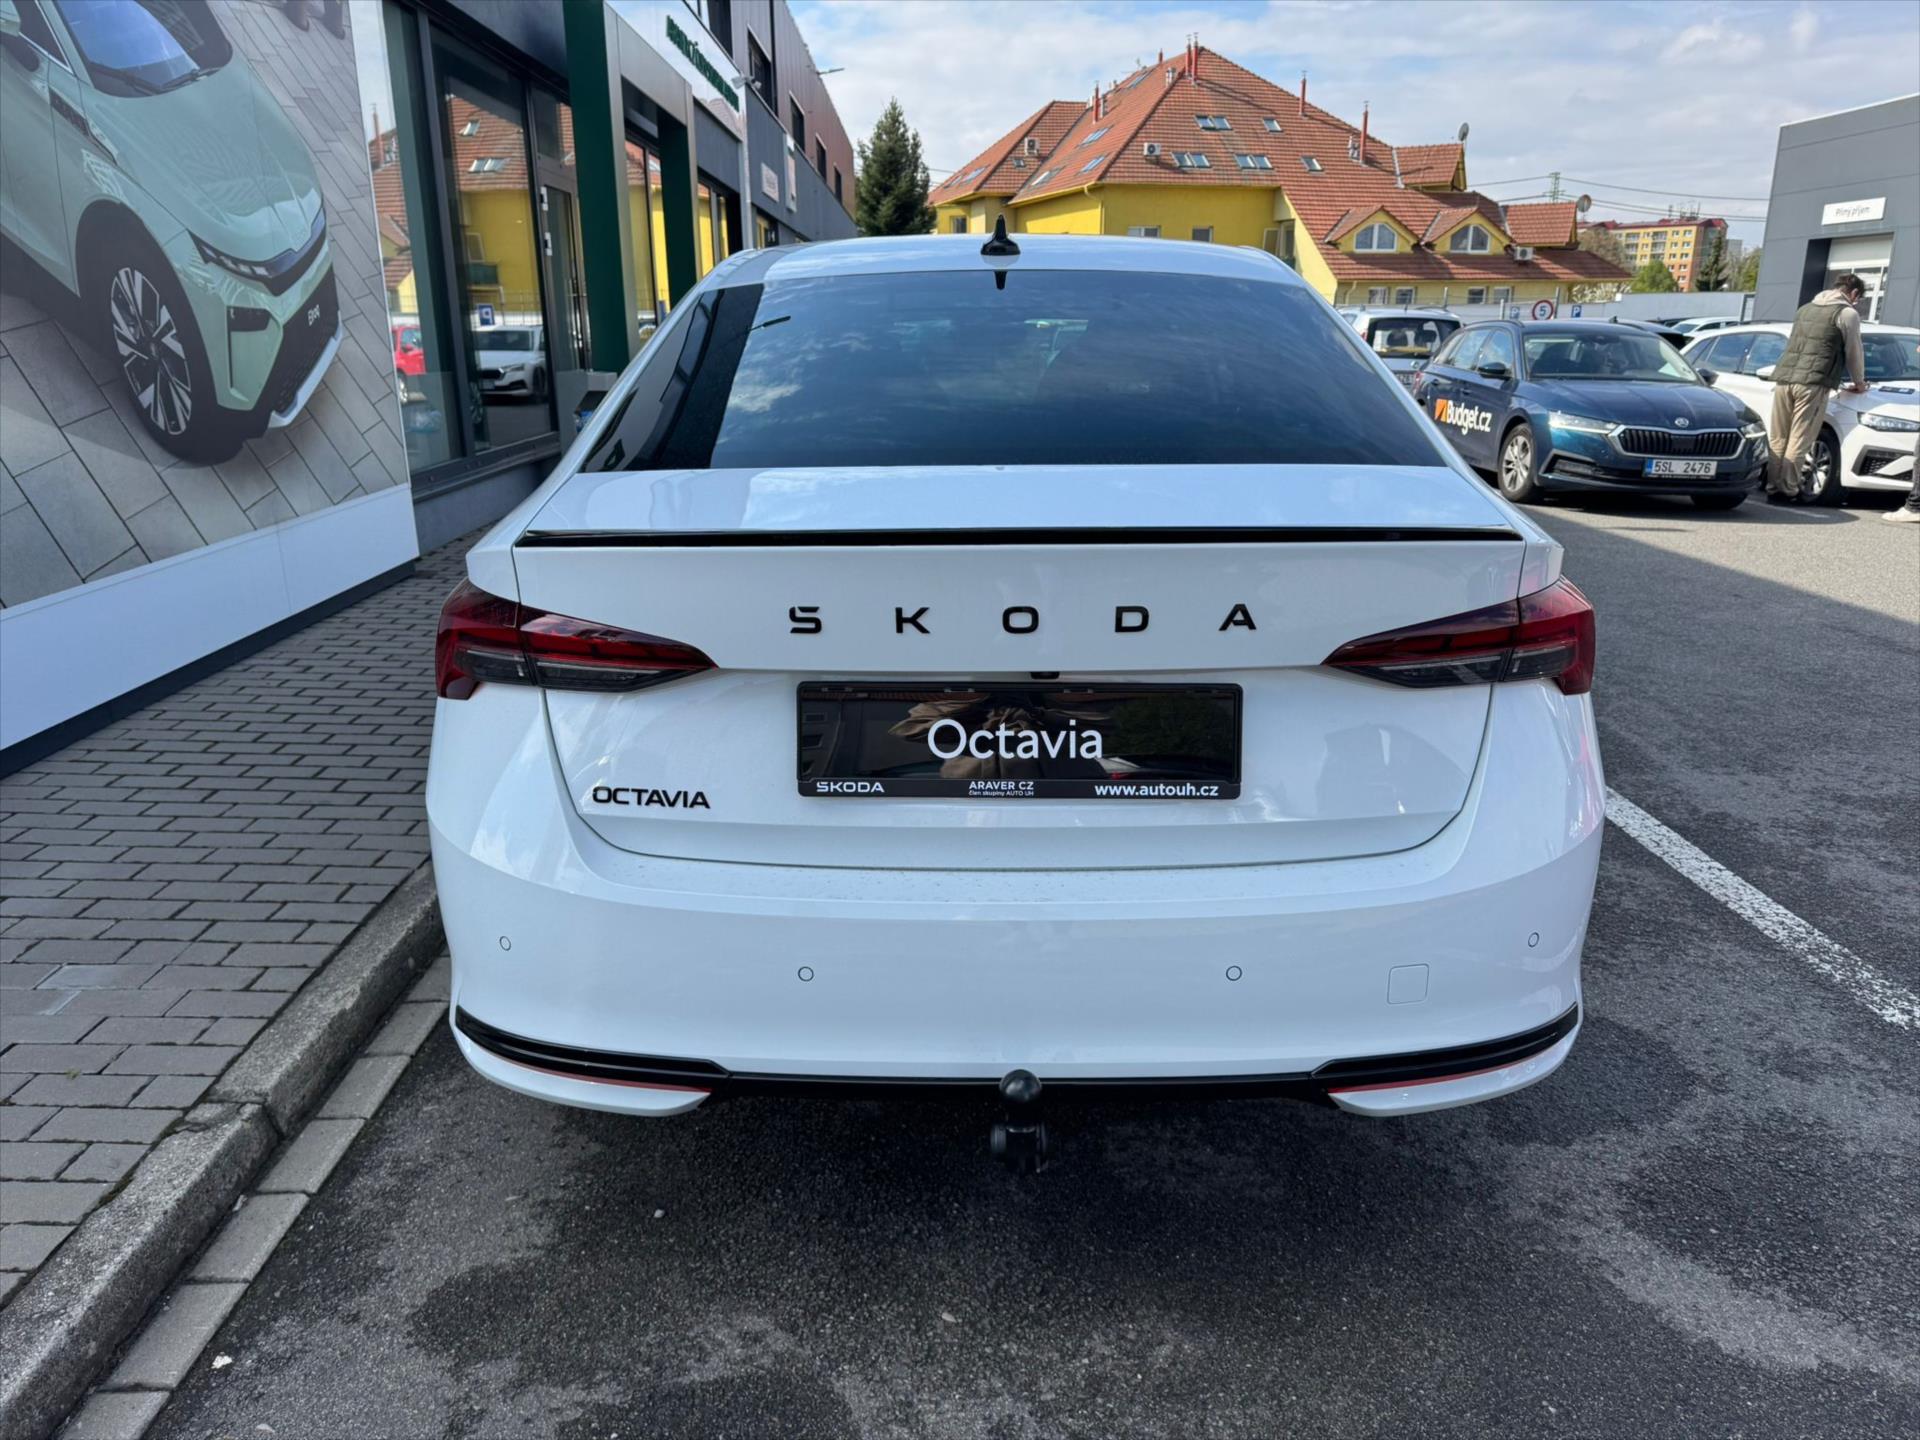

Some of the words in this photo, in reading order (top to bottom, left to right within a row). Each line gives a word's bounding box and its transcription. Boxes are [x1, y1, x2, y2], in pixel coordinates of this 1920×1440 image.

[1539, 305, 1547, 317] 5
[1447, 399, 1492, 436] Budget.cz
[1654, 461, 1674, 473] 5SL
[1683, 462, 1712, 474] 2476
[927, 718, 1103, 759] Octavia
[969, 781, 1015, 790] ARAVER
[1018, 781, 1034, 790] CZ
[1094, 783, 1219, 796] www.autouh.cz
[592, 786, 711, 809] OCTAVIA
